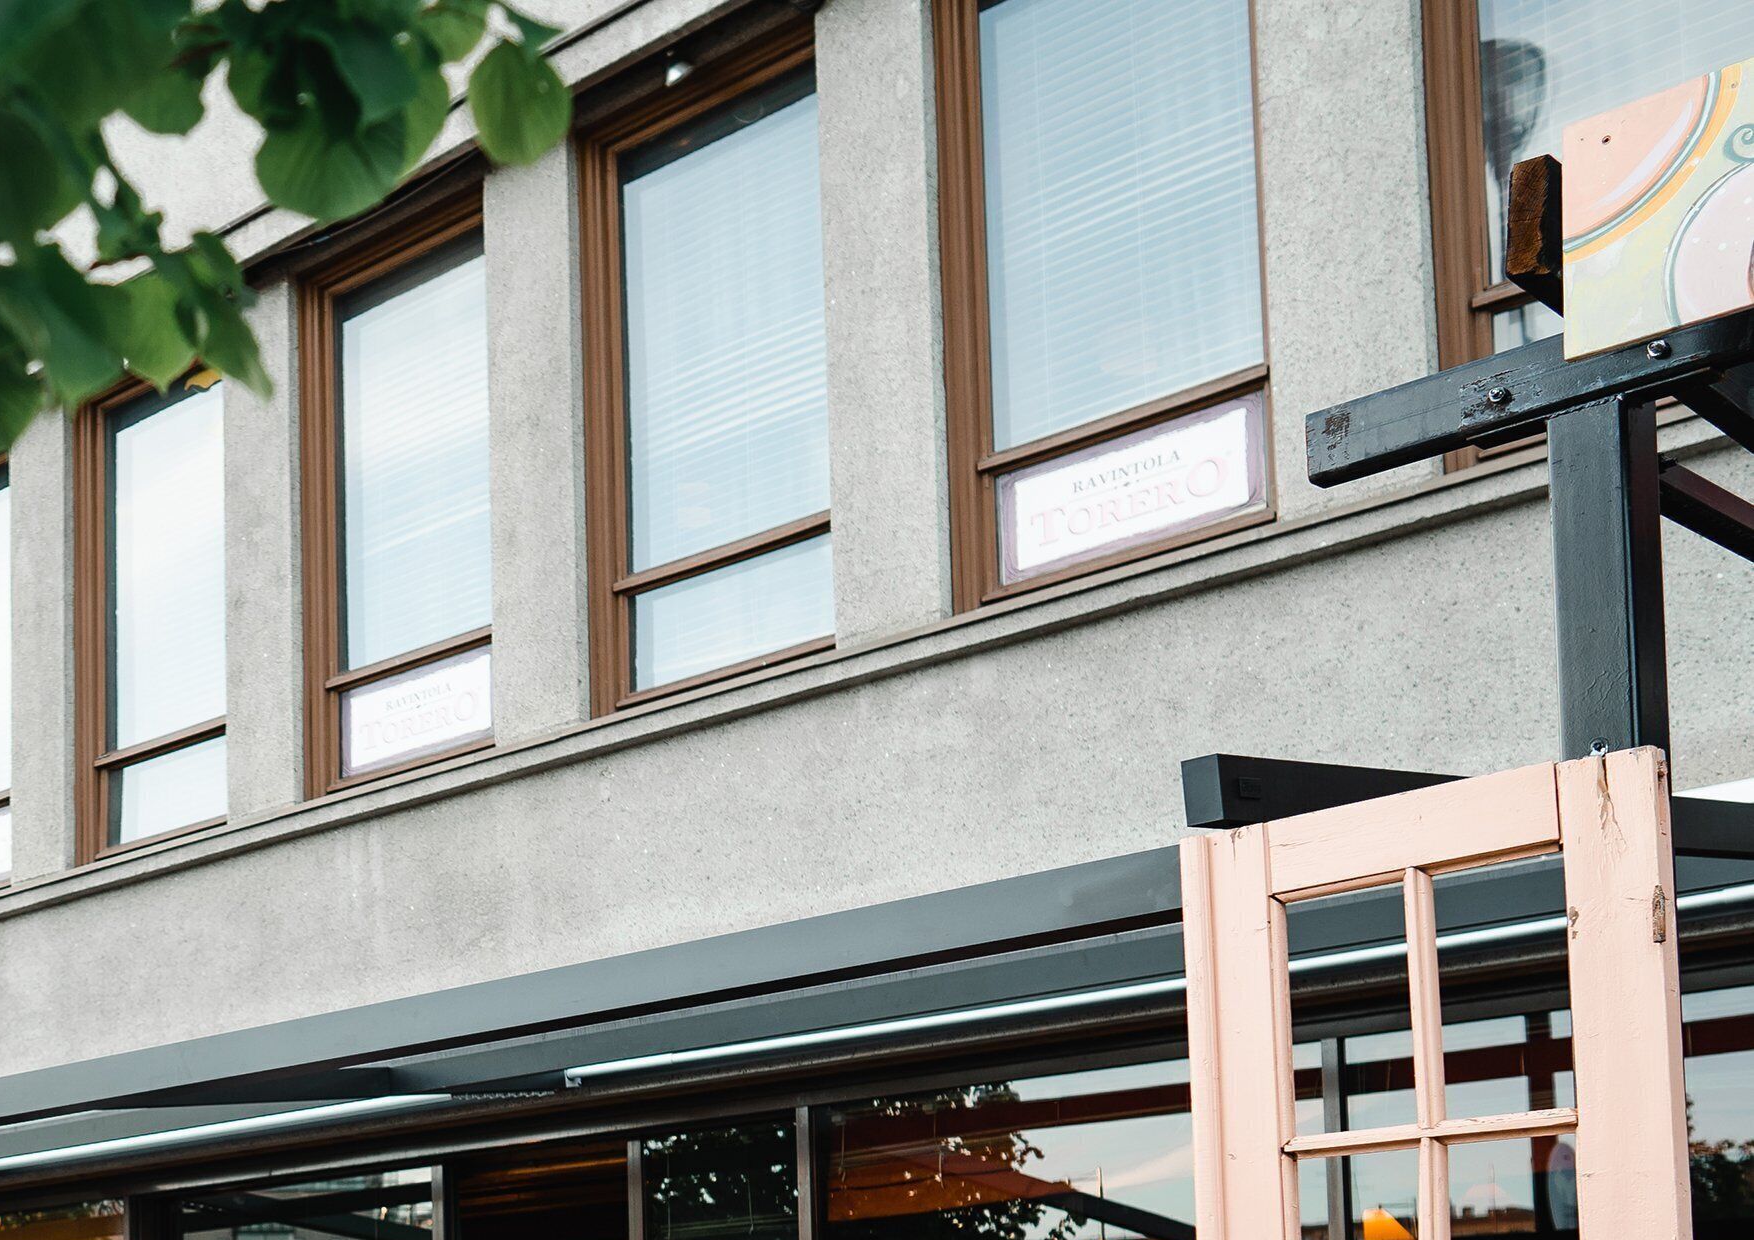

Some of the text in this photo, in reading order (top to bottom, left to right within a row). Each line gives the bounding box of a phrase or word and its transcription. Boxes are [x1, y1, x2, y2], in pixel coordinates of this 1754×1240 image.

[1029, 455, 1231, 547] TORERO
[1072, 450, 1181, 494] RAVINTOLA
[359, 691, 480, 751] TORERO
